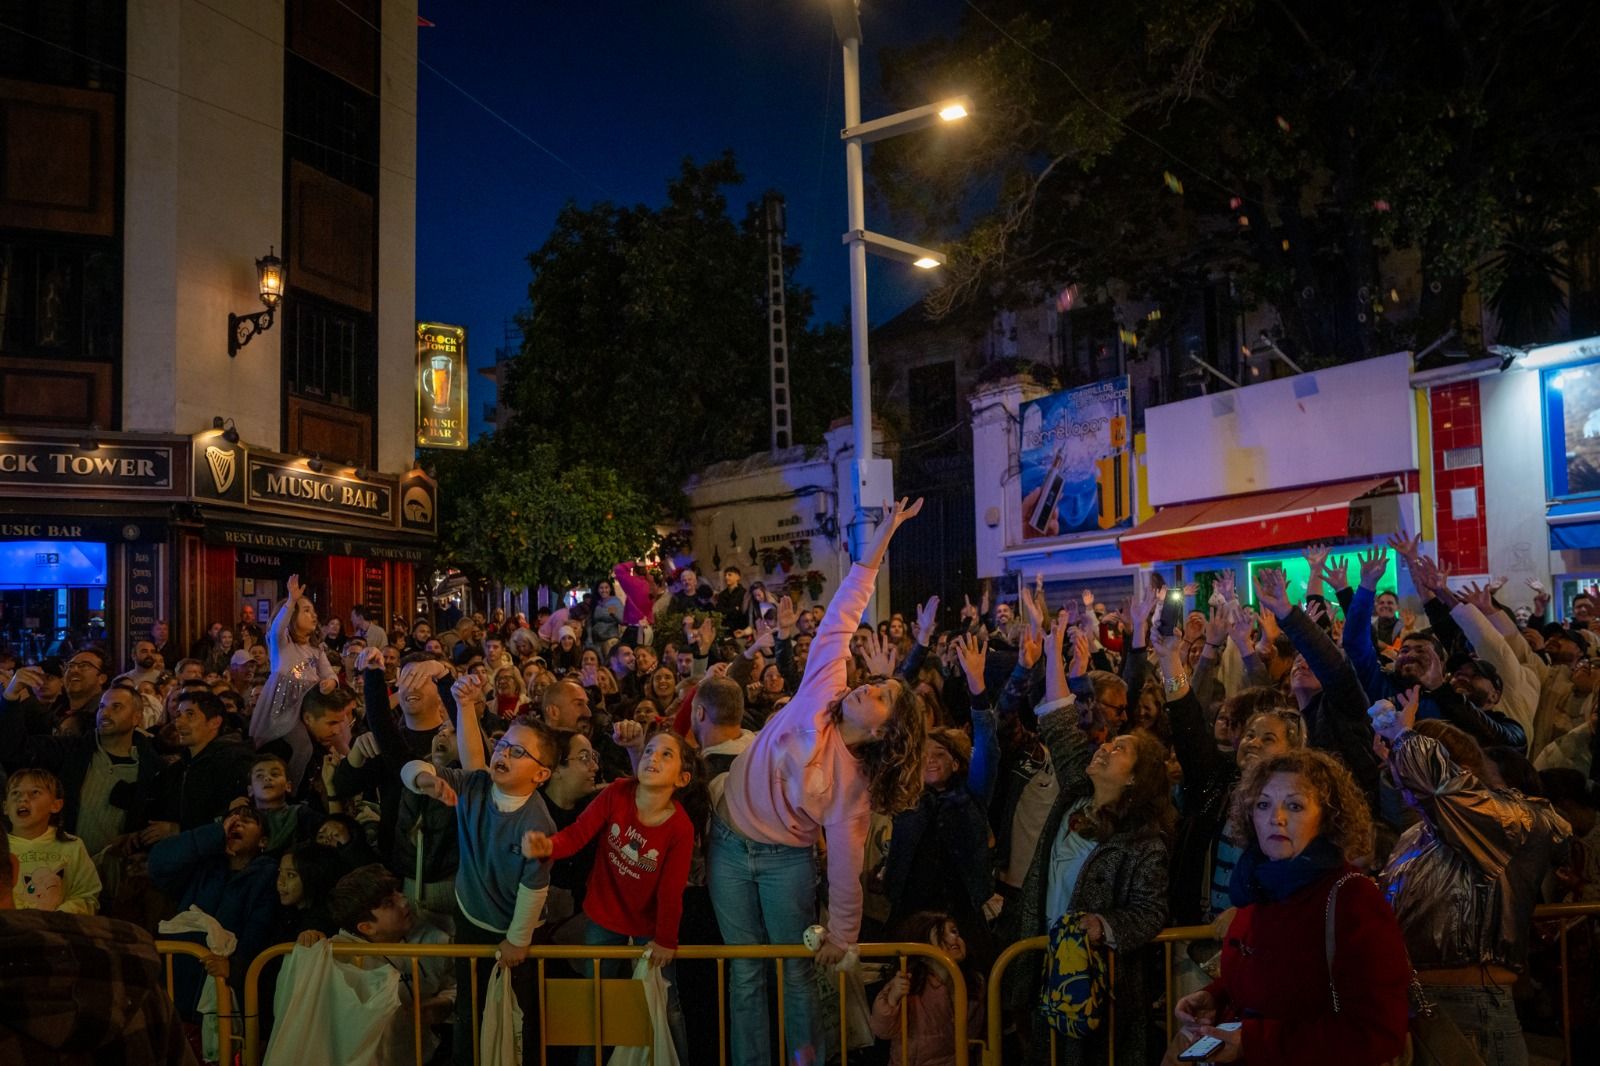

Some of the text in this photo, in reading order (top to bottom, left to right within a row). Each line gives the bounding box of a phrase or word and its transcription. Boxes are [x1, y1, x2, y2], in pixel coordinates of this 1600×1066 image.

[425, 342, 457, 353] TOWER
[424, 417, 458, 428] MUSIC
[430, 428, 452, 438] BAR
[49, 453, 156, 477] TOWER
[266, 472, 378, 510] MUSIC BAR
[47, 525, 82, 537] BAR
[225, 531, 295, 548] RESTAURANT
[243, 553, 280, 566] TOWER
